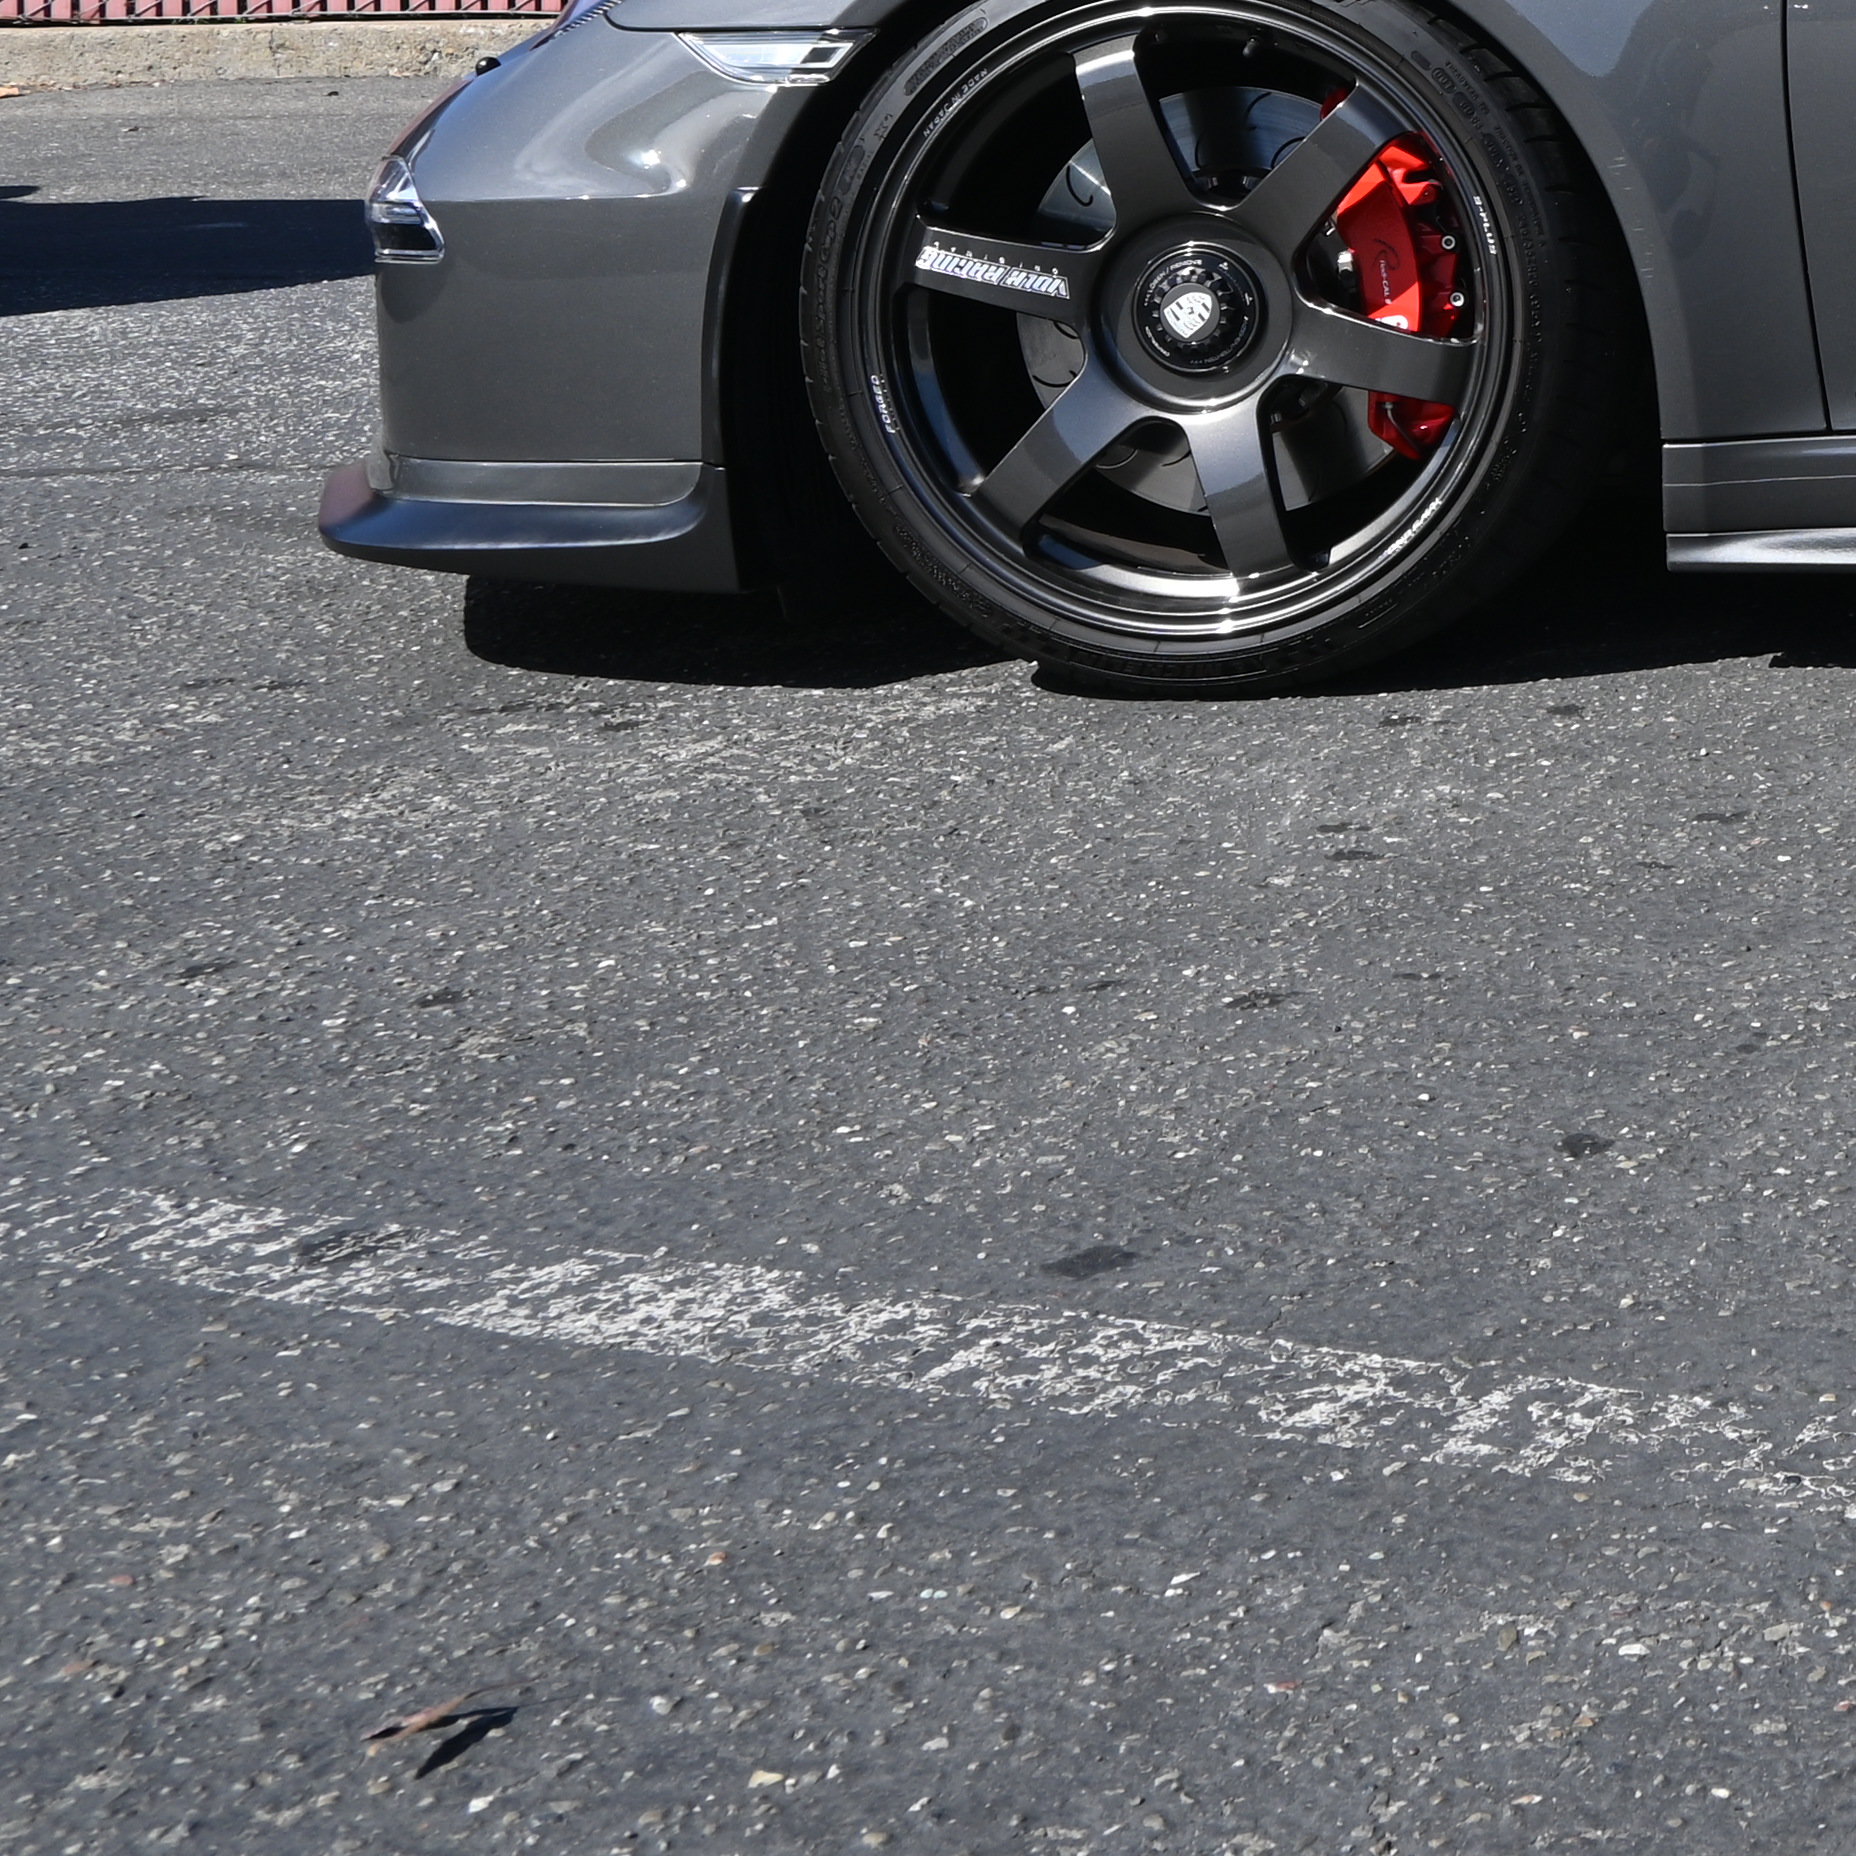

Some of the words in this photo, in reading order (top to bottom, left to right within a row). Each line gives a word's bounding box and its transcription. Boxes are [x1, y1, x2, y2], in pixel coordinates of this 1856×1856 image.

[961, 68, 988, 93] MADE
[922, 103, 950, 137] JAPAN
[820, 220, 836, 262] Cup
[830, 196, 843, 220] 2
[916, 246, 1007, 284] RACING
[1001, 269, 1068, 298] VOLK
[871, 375, 896, 433] FORGED
